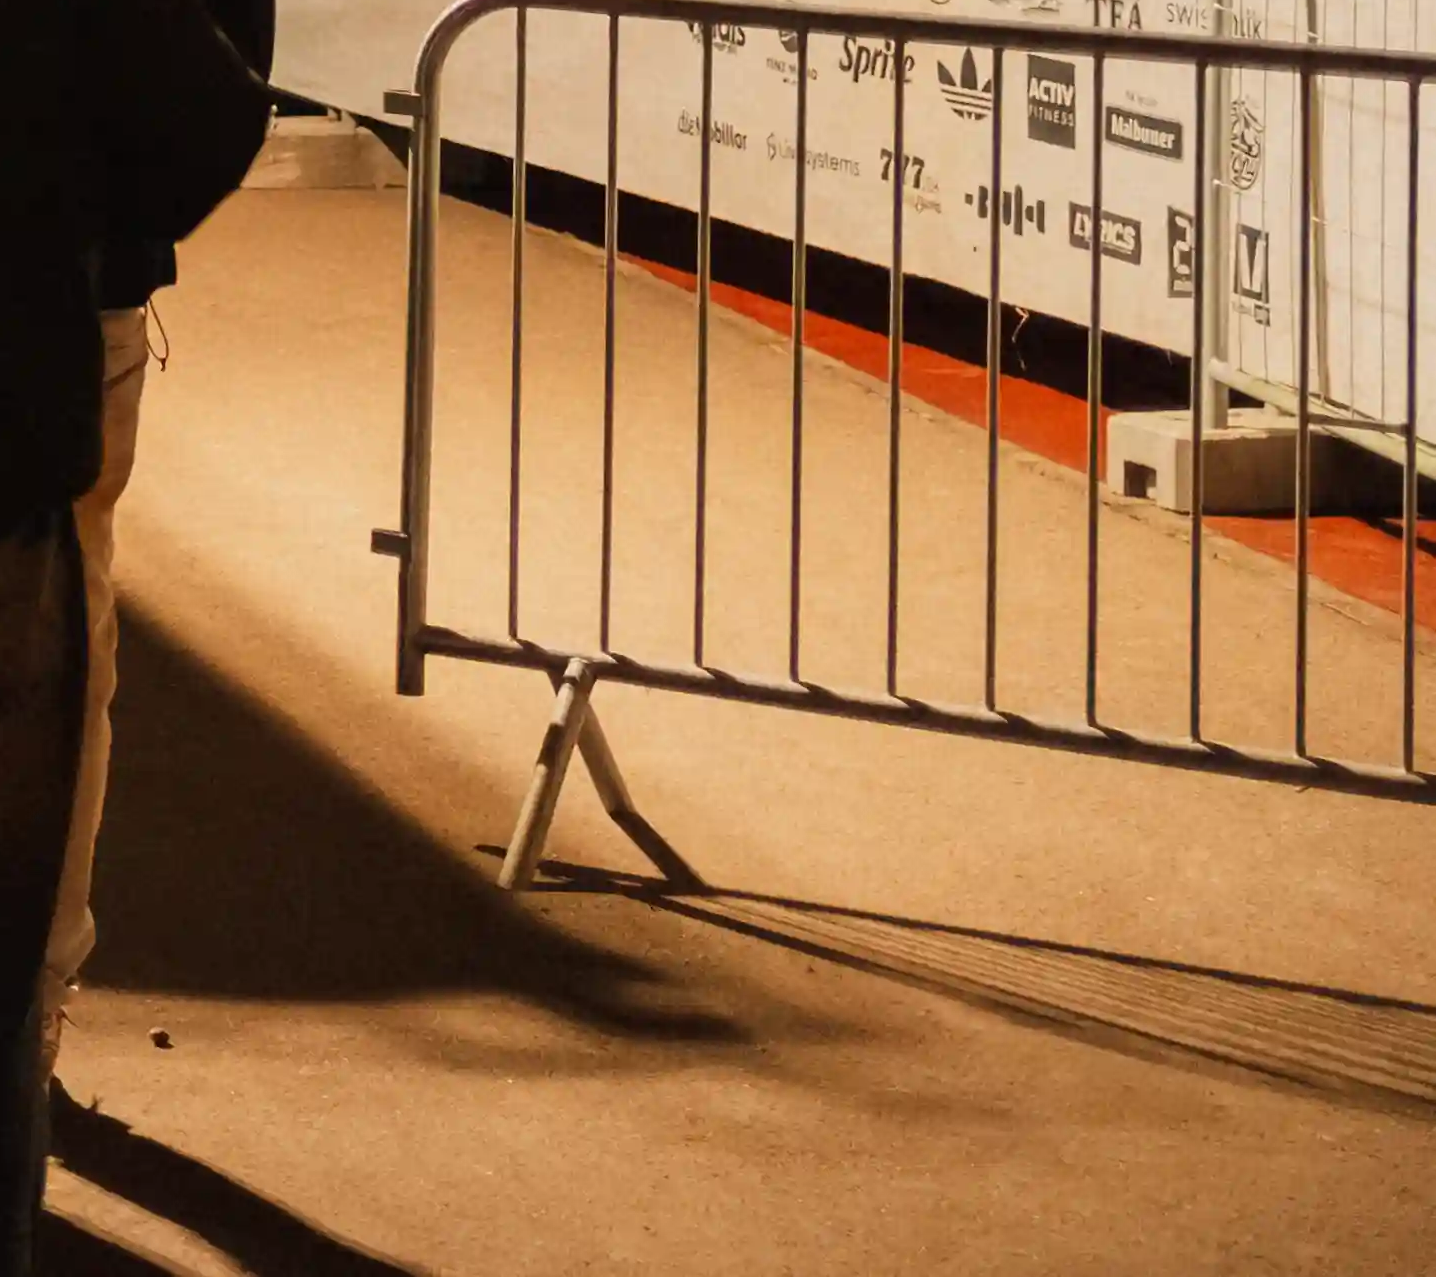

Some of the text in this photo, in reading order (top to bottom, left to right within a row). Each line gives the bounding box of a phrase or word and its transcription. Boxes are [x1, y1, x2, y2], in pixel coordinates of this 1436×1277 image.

[1028, 76, 1074, 107] ACTIV
[1028, 104, 1075, 128] FITNESS
[1110, 112, 1176, 150] Malbuner
